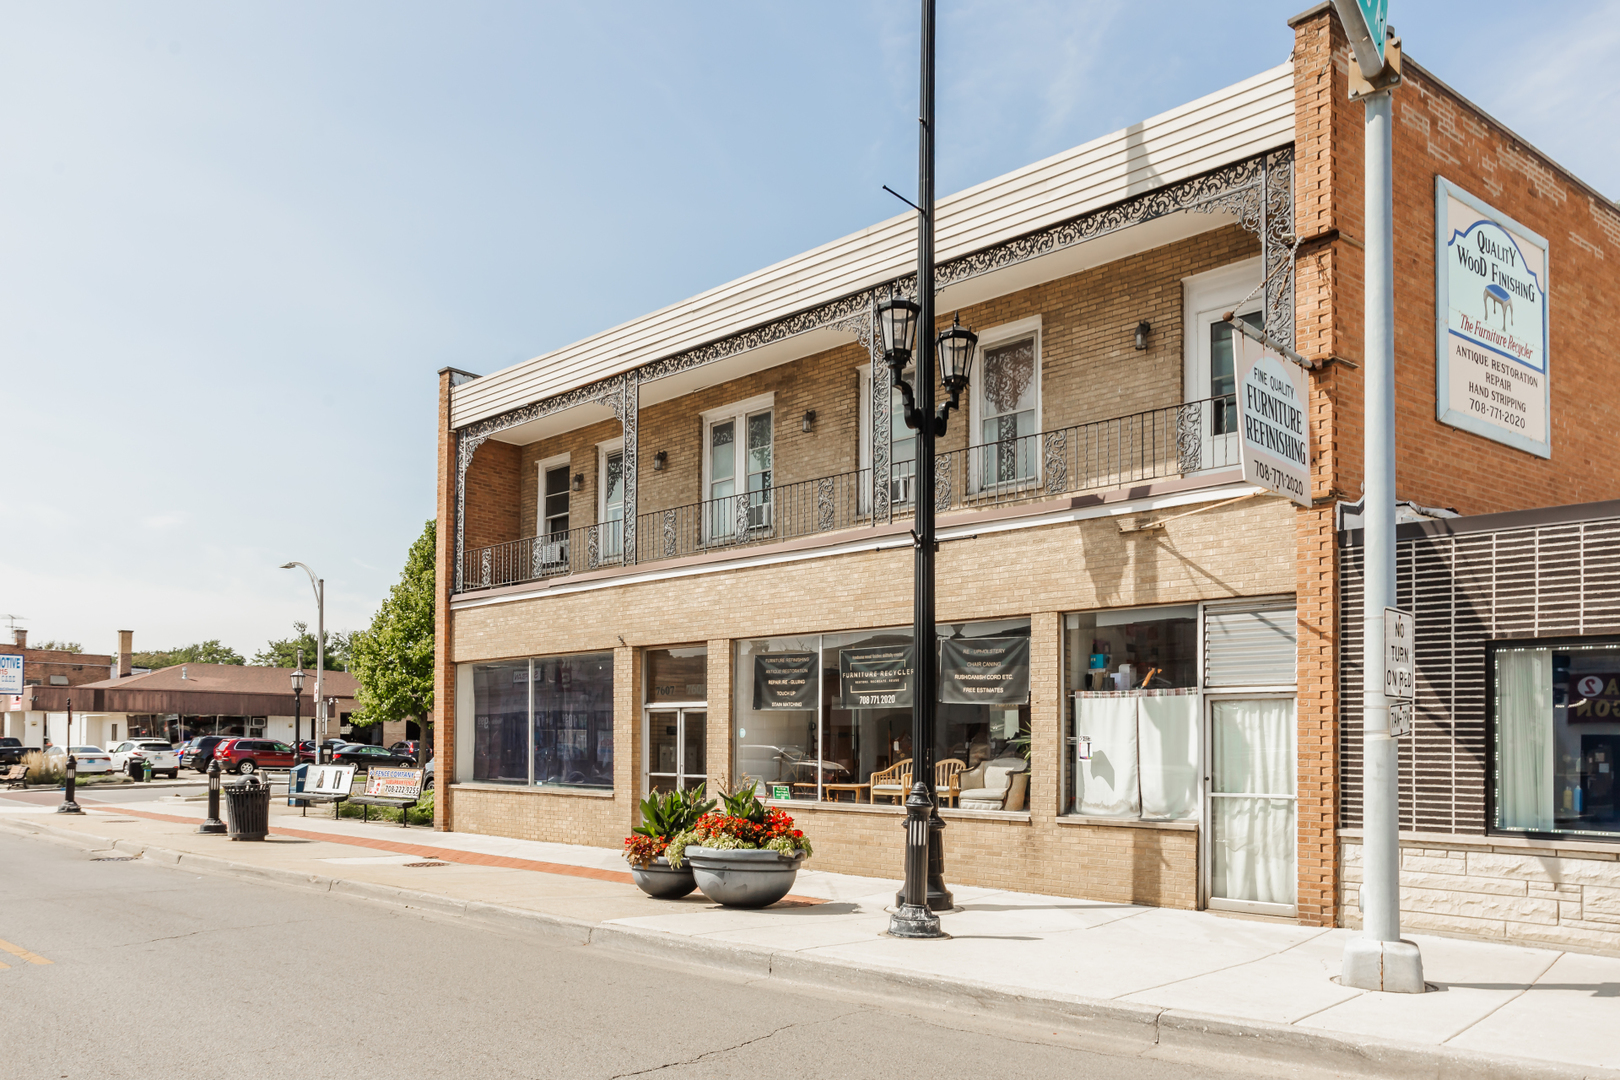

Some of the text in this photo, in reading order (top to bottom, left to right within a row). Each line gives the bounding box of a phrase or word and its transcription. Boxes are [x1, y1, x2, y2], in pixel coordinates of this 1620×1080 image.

[1477, 231, 1517, 267] QUALITY
[1492, 263, 1535, 303] FINISHING
[1460, 314, 1533, 360] The Furniture Recycler
[1456, 345, 1538, 388] ANTIQUE RESTORATION
[1253, 367, 1295, 398] FINE QUALITY
[1468, 382, 1526, 413] HAND STRIPPING
[1485, 373, 1512, 392] REPAIR
[1246, 384, 1303, 435] FURNITURE
[1469, 398, 1526, 428] 708-771-2020
[1245, 416, 1306, 466] REFINISHING
[1254, 460, 1304, 496] 708-771-2020
[1395, 622, 1404, 638] NO
[0, 658, 20, 668] OTIVE
[1391, 646, 1408, 664] TURN
[656, 686, 674, 696] 7607
[1387, 670, 1411, 688] ON RED
[860, 695, 895, 704] 708 771 2020
